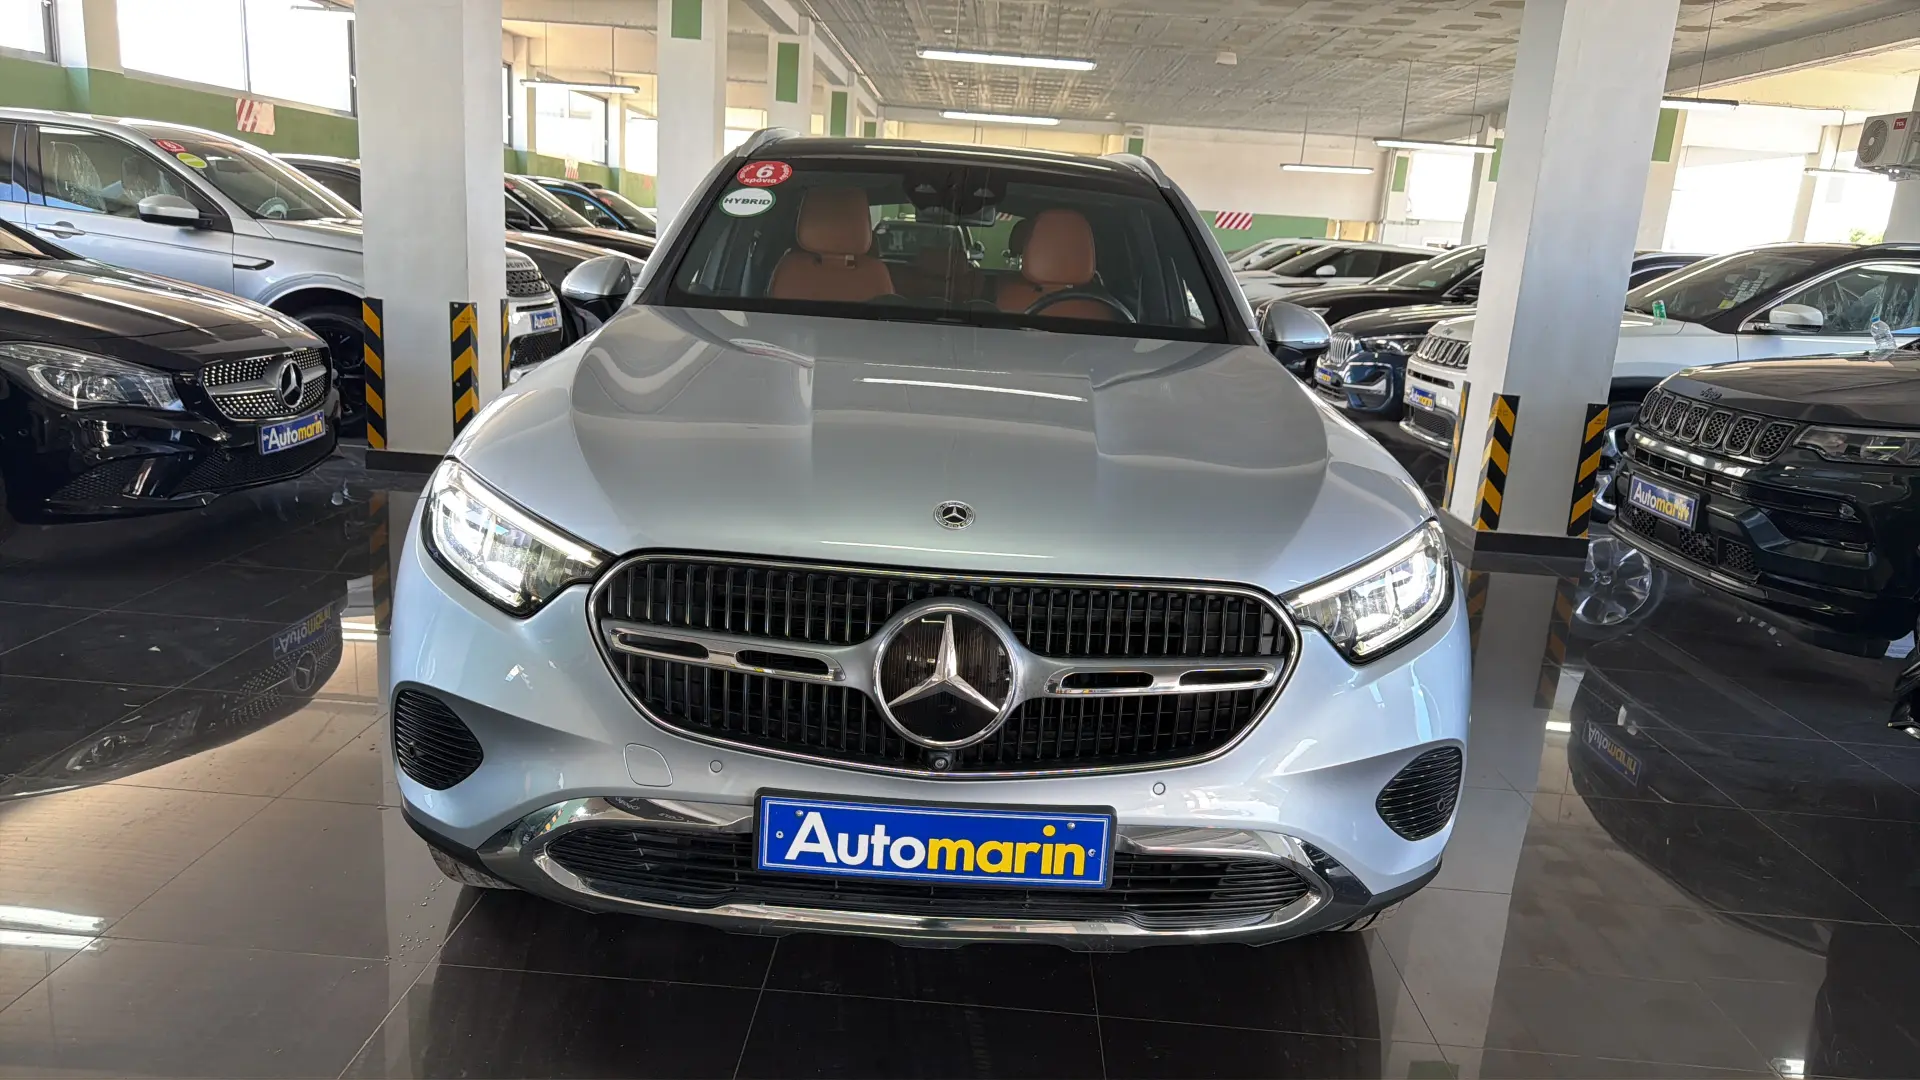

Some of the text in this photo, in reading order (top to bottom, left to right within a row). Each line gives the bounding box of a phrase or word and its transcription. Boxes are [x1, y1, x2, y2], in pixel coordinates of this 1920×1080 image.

[756, 166, 775, 178] 6
[268, 415, 323, 449] Automarin
[1633, 482, 1690, 521] Automarin
[784, 811, 1086, 876] Automarin
